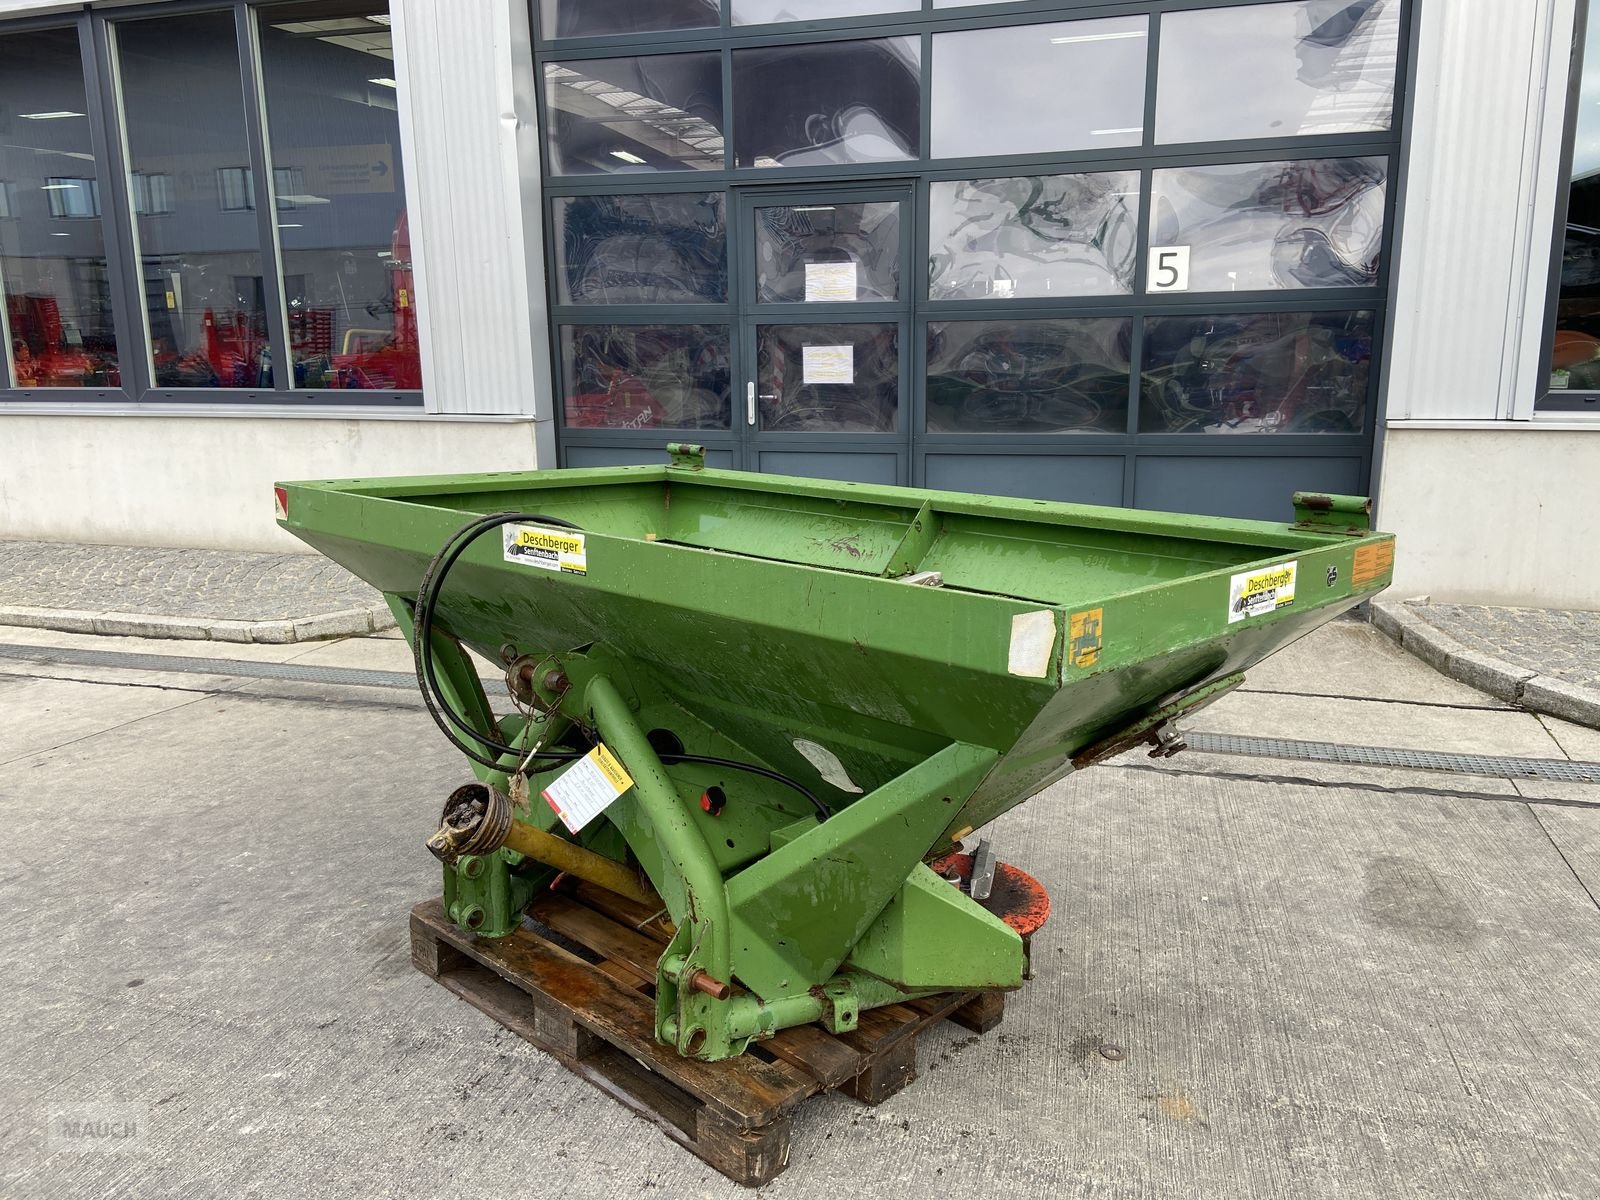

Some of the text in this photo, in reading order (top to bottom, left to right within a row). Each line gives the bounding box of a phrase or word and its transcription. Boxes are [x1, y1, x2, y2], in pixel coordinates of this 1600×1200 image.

[1156, 252, 1178, 287] 5
[523, 532, 578, 553] Deschberger
[524, 547, 558, 560] Senftenbach
[1248, 570, 1291, 592] Deschberger
